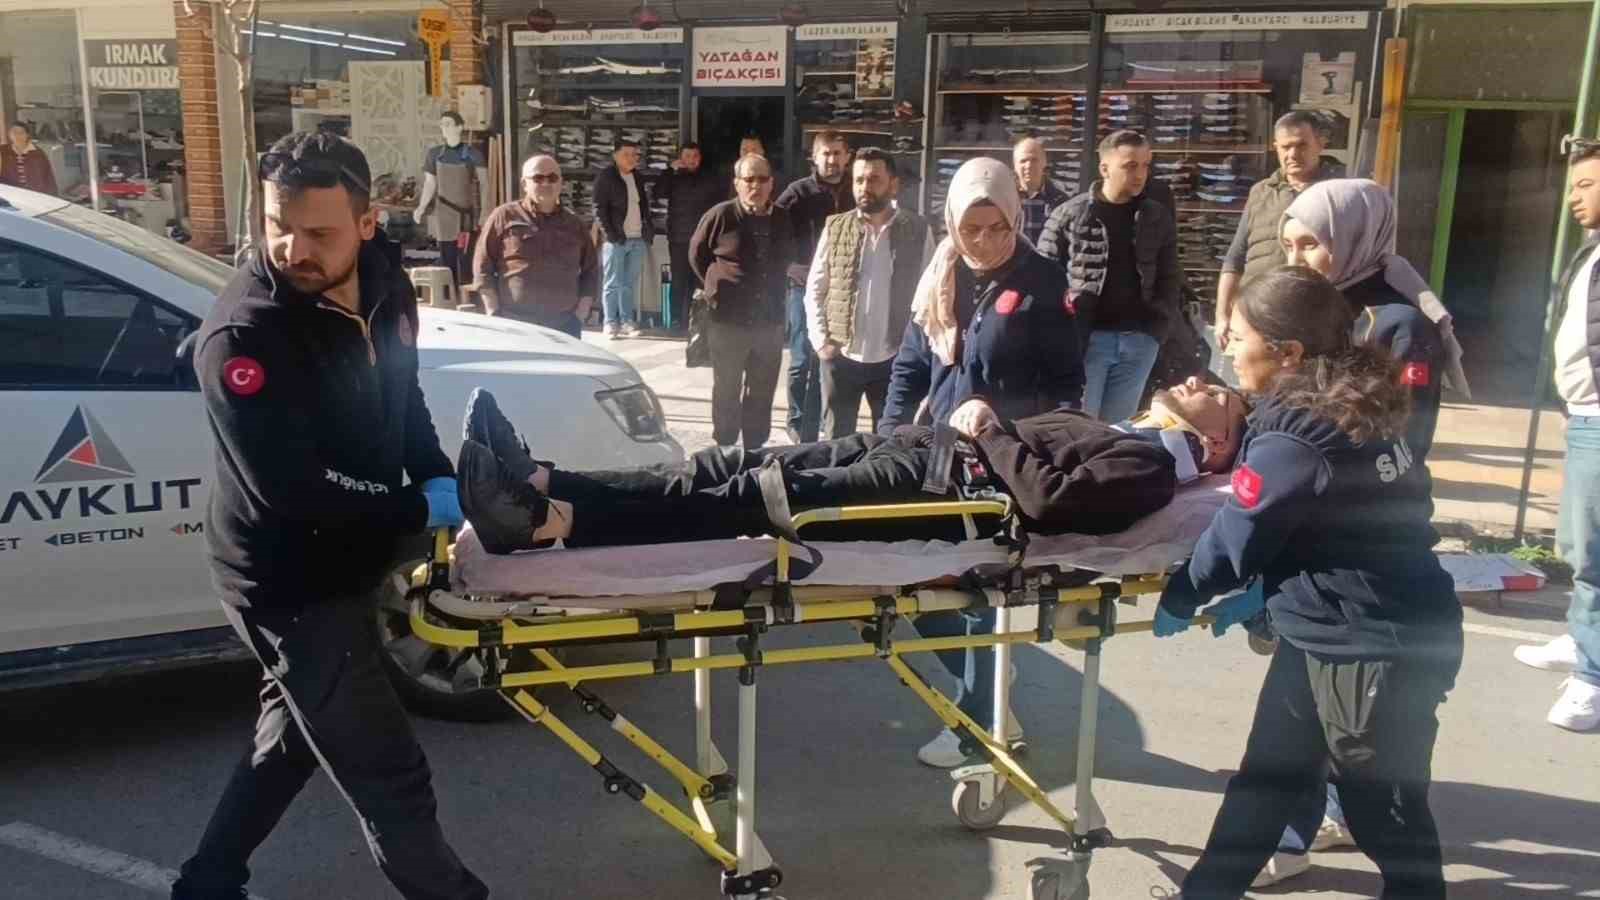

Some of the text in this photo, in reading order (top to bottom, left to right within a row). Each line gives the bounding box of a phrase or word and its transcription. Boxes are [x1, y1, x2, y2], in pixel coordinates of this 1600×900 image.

[104, 44, 167, 65] IRMAK
[699, 49, 779, 63] YATAĞAN
[696, 68, 781, 82] BIÇAKÇISI
[0, 478, 202, 524] AYKUT
[60, 527, 145, 546] BETON
